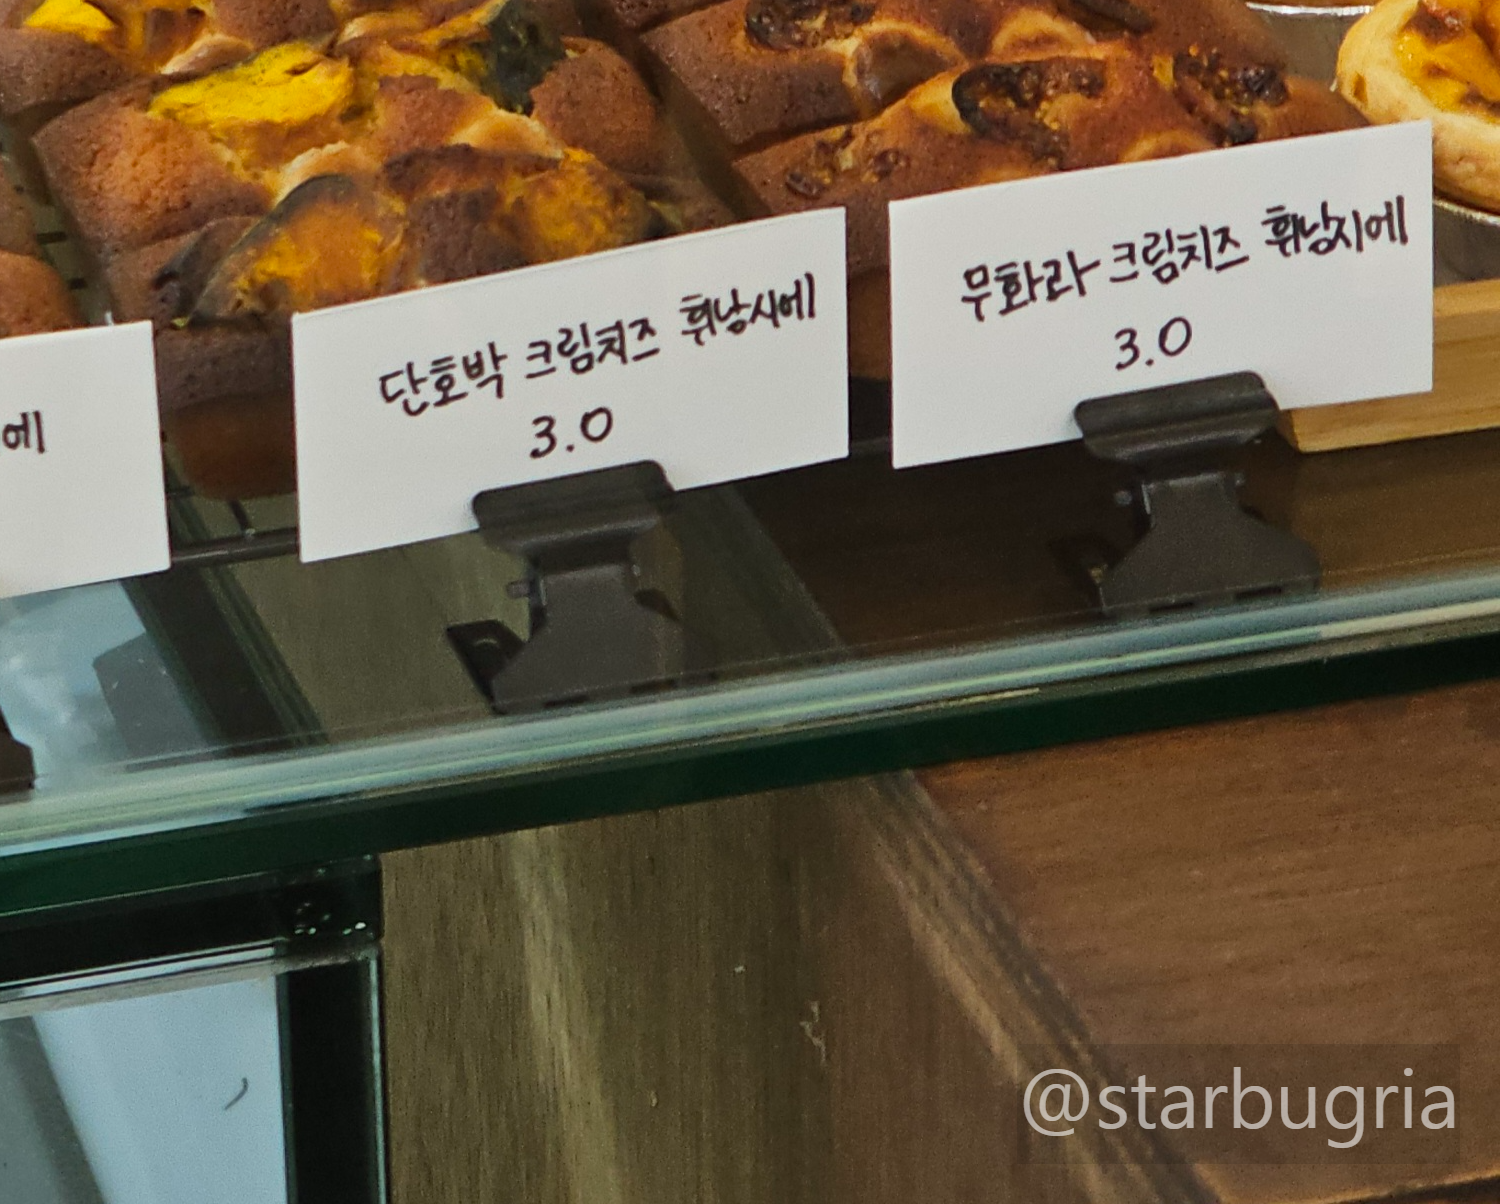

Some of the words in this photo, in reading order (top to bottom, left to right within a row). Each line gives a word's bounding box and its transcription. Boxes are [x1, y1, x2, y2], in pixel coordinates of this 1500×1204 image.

[1109, 224, 1250, 285] 크림치즈
[1260, 194, 1409, 258] 휘낭시에
[378, 341, 508, 417] 단호박
[525, 317, 661, 380] 크림치즈
[679, 271, 816, 347] 휘낭시에
[1114, 316, 1193, 371] 3.0
[529, 406, 614, 460] 3.0
